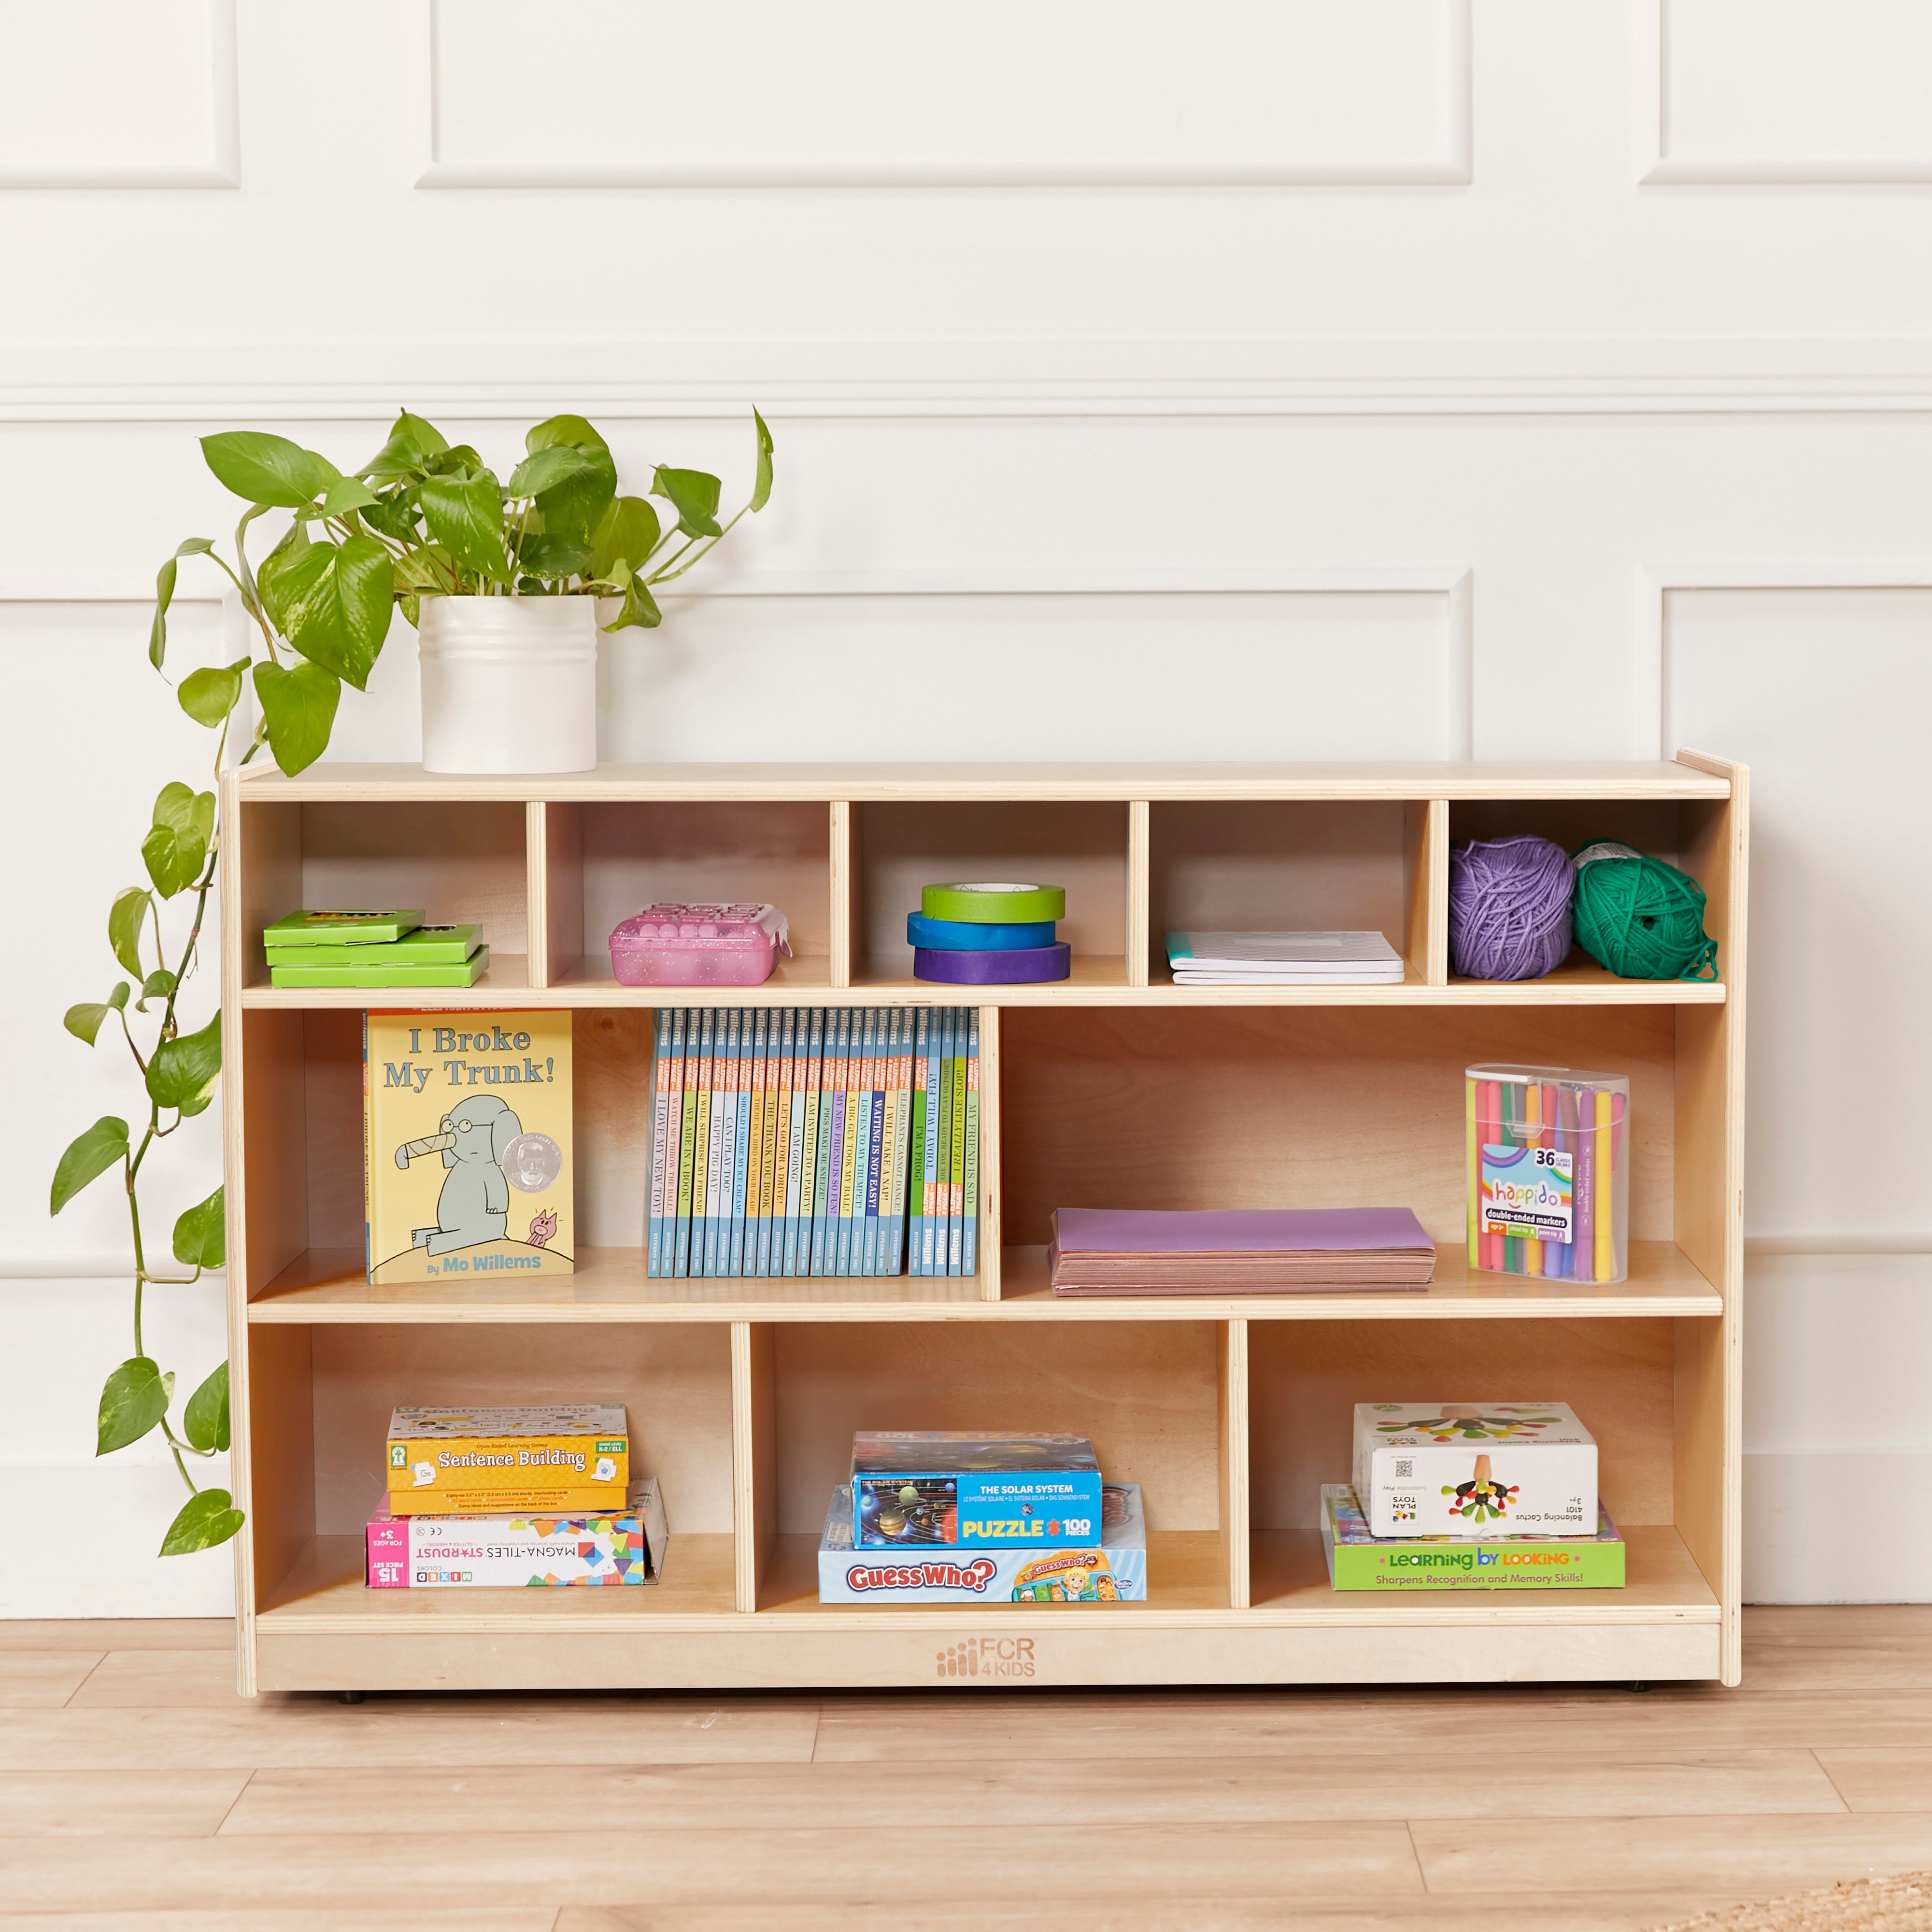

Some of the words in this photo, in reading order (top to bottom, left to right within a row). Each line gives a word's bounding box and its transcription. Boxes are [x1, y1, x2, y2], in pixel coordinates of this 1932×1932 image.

[660, 1010, 670, 1046] Willems
[689, 1009, 699, 1046] Willems
[729, 1010, 739, 1046] Willems
[409, 1029, 421, 1053] I
[433, 1026, 530, 1053] Broke
[384, 1062, 433, 1093] My
[443, 1057, 554, 1085] Trunk!
[928, 1073, 937, 1095] FLY!
[955, 1069, 964, 1096] SLOP!
[656, 1106, 665, 1135] LOVE
[766, 1100, 774, 1120] THE
[871, 1099, 882, 1142] WAITING
[927, 1098, 936, 1125] WILL
[954, 1099, 963, 1122] LIKE
[968, 1104, 976, 1122] MY
[712, 1116, 721, 1147] HAPPY
[779, 1130, 787, 1142] GO
[885, 1112, 893, 1137] WILL
[915, 1125, 923, 1140] I'M
[655, 1138, 664, 1156] MY
[765, 1123, 773, 1156] THANK
[792, 1132, 800, 1146] AM
[871, 1145, 880, 1154] IS
[953, 1124, 962, 1165] REALLY
[967, 1124, 976, 1165] FRIEND
[711, 1151, 719, 1166] PIG
[724, 1144, 732, 1167] PLAY
[883, 1139, 892, 1166] TAKE
[925, 1136, 935, 1169] TODAY
[1536, 1151, 1555, 1166] 36
[654, 1158, 663, 1184] NEW
[697, 1165, 703, 1177] MY
[763, 1159, 771, 1179] YOU
[790, 1149, 799, 1182] GOING!
[870, 1156, 879, 1177] NOT
[913, 1152, 922, 1181] FROG!
[966, 1168, 975, 1179] IS
[710, 1170, 718, 1192] DAY!
[723, 1169, 731, 1192] TOO?
[776, 1174, 784, 1204] DRIVE!
[881, 1178, 890, 1200] NAP!
[653, 1187, 661, 1212] TOY!
[762, 1181, 770, 1208] BOOK
[868, 1179, 878, 1208] EASY!
[966, 1182, 974, 1204] SAD
[1496, 1182, 1558, 1206] happido
[1487, 1210, 1535, 1223] double-ended
[1536, 1216, 1565, 1227] markers
[923, 1228, 932, 1264] Willems
[937, 1229, 945, 1265] Willems
[951, 1229, 960, 1265] Willems
[427, 1264, 440, 1275] By
[443, 1257, 469, 1273] Mo
[473, 1254, 541, 1271] Willems
[438, 1451, 514, 1468] Sentence
[518, 1449, 586, 1472] Building
[420, 1469, 431, 1477] Go
[1001, 1486, 1033, 1494] SOLAR
[1035, 1485, 1073, 1493] SYSTEM
[963, 1520, 1044, 1537] PUZZLE
[1063, 1519, 1091, 1531] 100
[1544, 1513, 1582, 1521] Balancing
[380, 1530, 394, 1539] 3+
[487, 1547, 575, 1557] MAGNA-TILES
[379, 1568, 398, 1582] 15
[849, 1567, 923, 1591] Guess
[923, 1560, 994, 1591] Who?
[1033, 1561, 1062, 1575] Guess
[1061, 1554, 1086, 1568] Who?
[418, 1572, 472, 1581] MIXED
[1376, 1575, 1423, 1586] Sharpens
[1426, 1575, 1485, 1585] Recognition
[1488, 1575, 1507, 1583] and
[1510, 1574, 1551, 1584] Memory
[1555, 1573, 1583, 1582] Skills!
[980, 1638, 1035, 1661] FCR
[981, 1663, 991, 1676] 4
[994, 1662, 1036, 1677] KIDS
